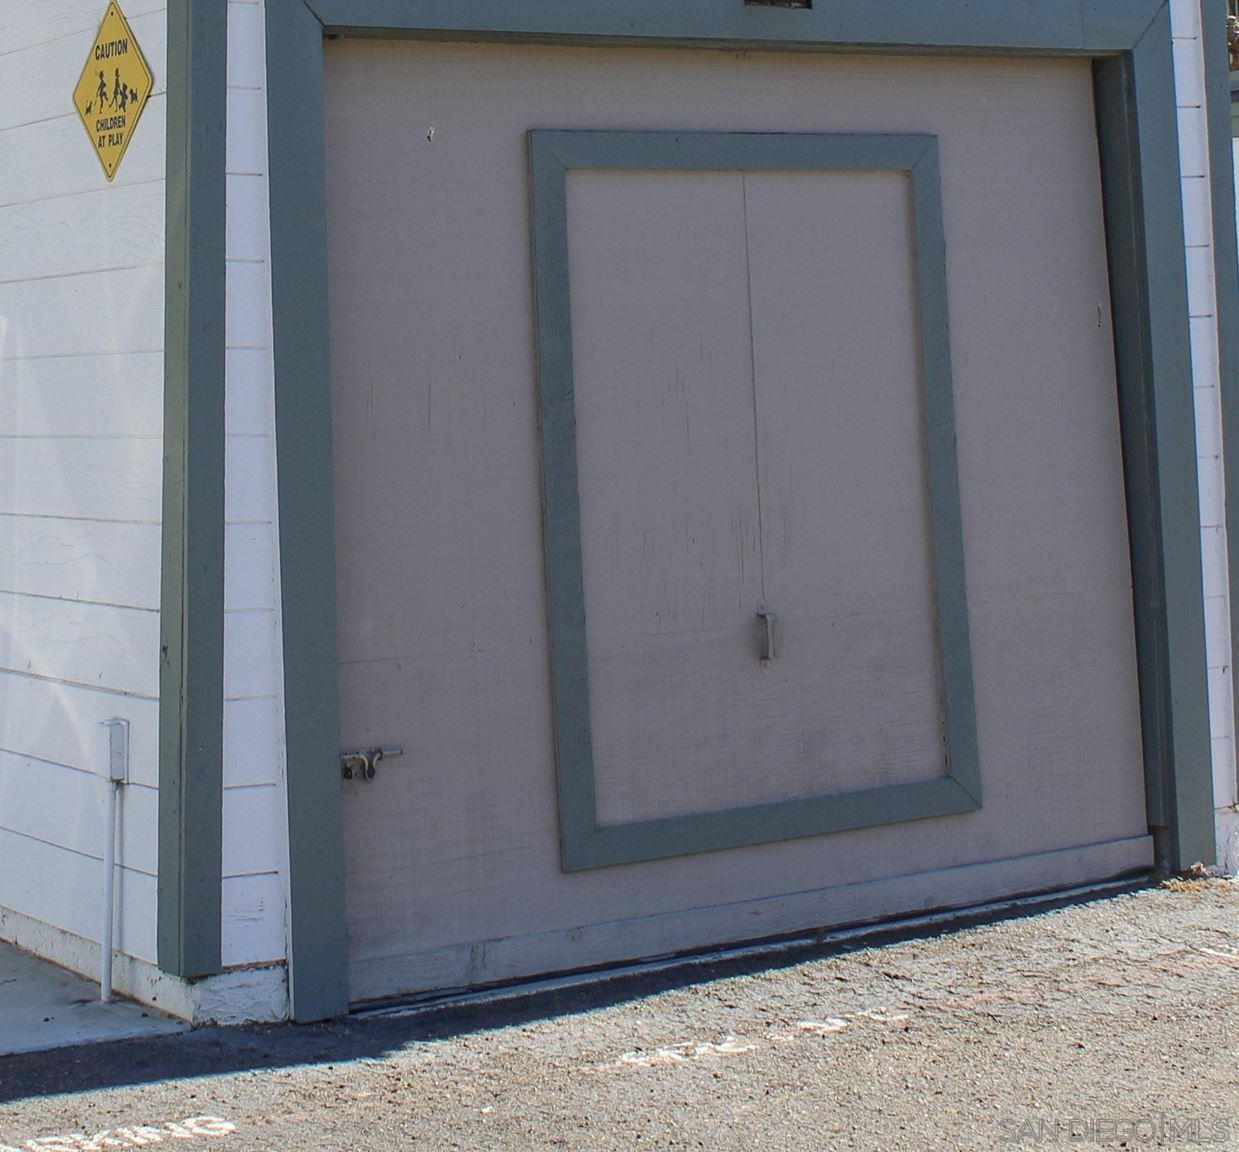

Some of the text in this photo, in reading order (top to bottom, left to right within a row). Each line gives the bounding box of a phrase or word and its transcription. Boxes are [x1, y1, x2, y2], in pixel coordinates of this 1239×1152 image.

[95, 38, 128, 61] CAUTION
[95, 114, 126, 133] CHILDREN
[97, 132, 124, 149] AT PLAY
